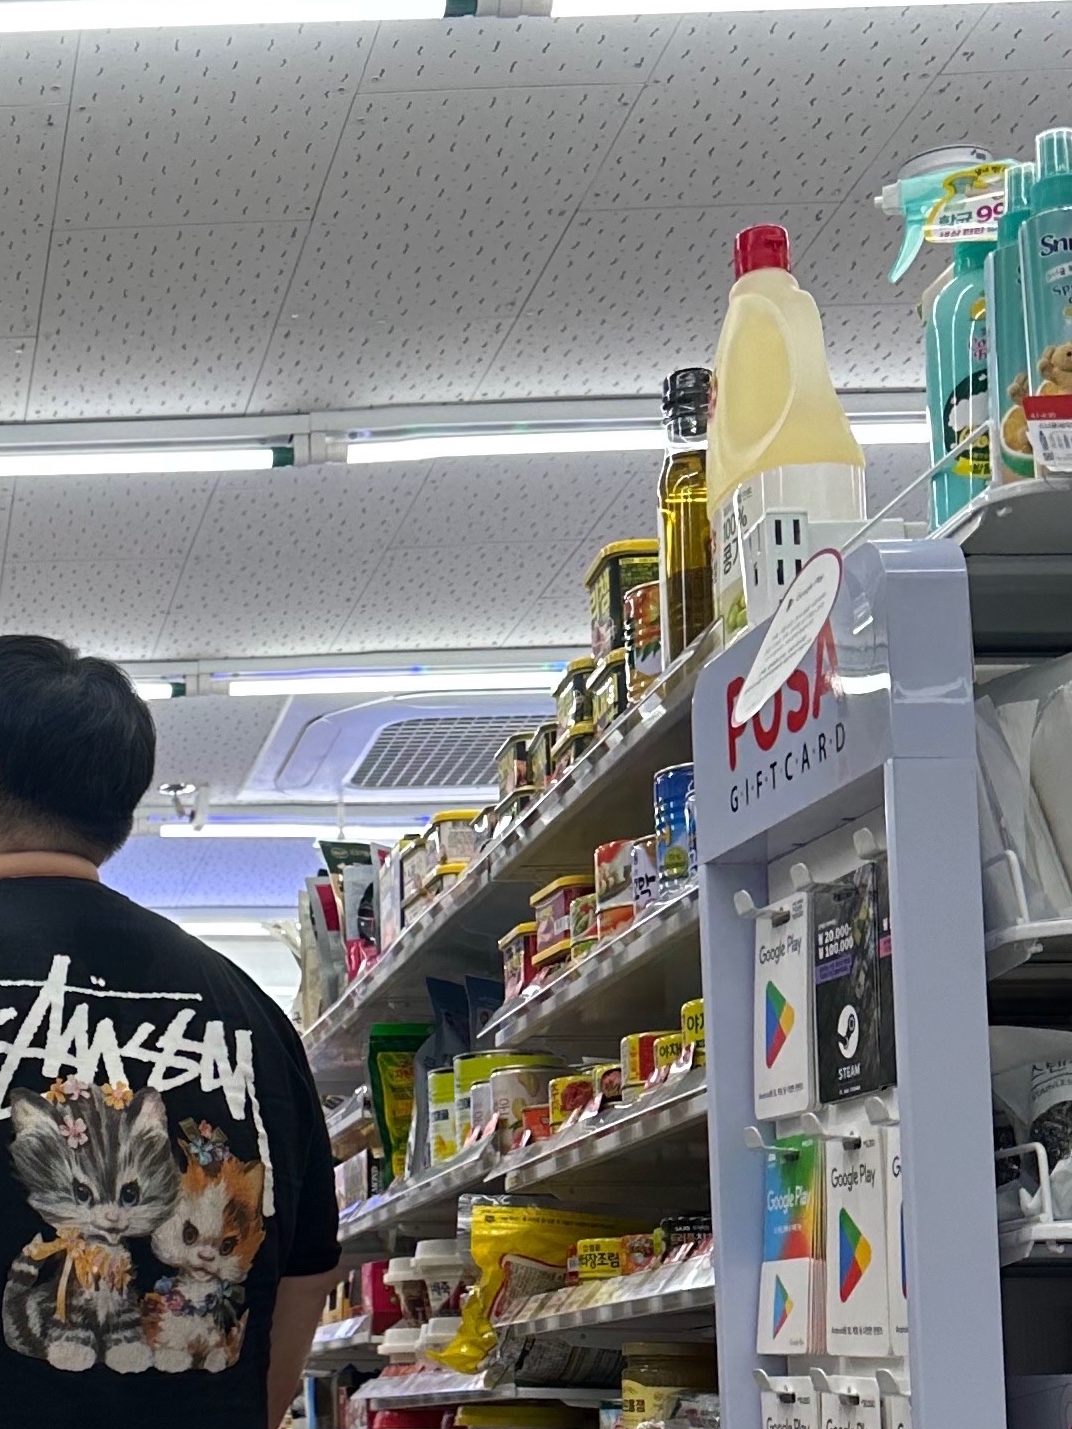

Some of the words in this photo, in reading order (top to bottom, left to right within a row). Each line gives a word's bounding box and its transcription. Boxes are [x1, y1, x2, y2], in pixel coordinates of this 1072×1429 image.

[759, 942, 786, 966] Google
[787, 934, 803, 955] Play
[838, 1064, 861, 1081] STEAM
[831, 1167, 859, 1192] Google
[859, 1164, 876, 1188] Play
[767, 1189, 795, 1215] Google
